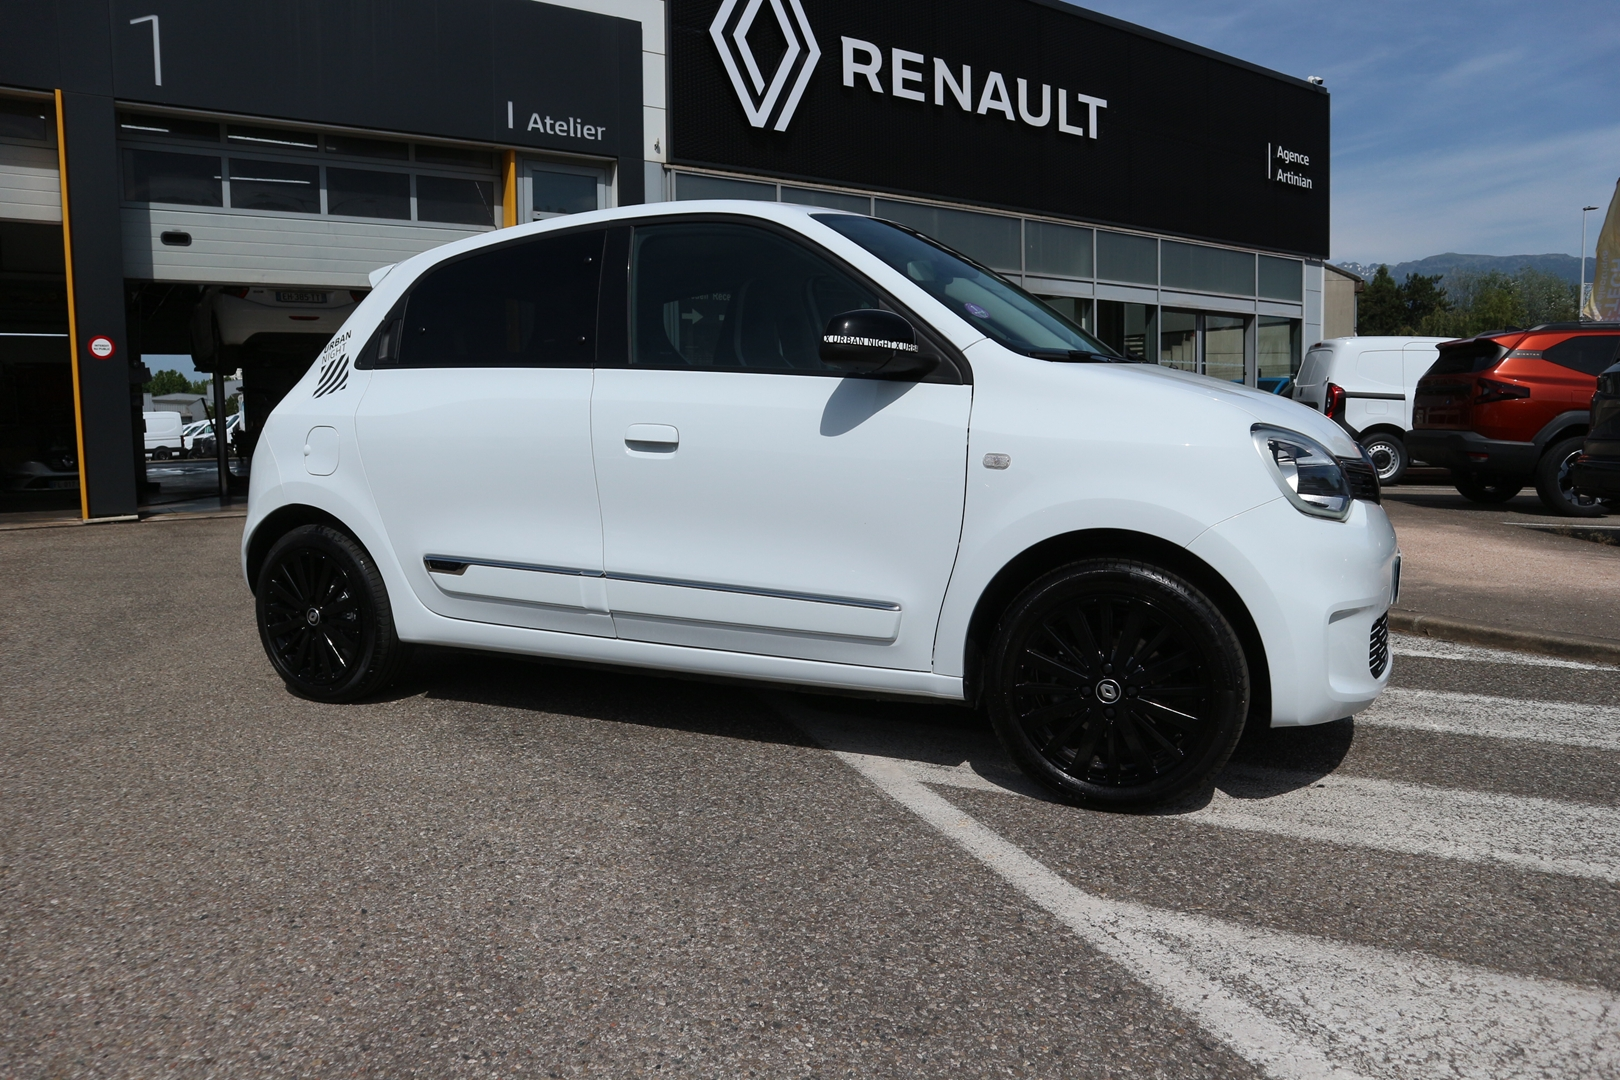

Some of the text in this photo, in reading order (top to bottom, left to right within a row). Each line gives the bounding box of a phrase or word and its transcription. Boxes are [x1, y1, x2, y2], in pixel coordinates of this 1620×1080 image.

[129, 14, 162, 87] 1
[840, 35, 1108, 140] RENAULT
[527, 112, 606, 141] Atelier
[1276, 145, 1310, 166] Agence
[1276, 168, 1313, 189] Artinian
[321, 342, 347, 364] NIGHT
[323, 330, 352, 354] URBAN
